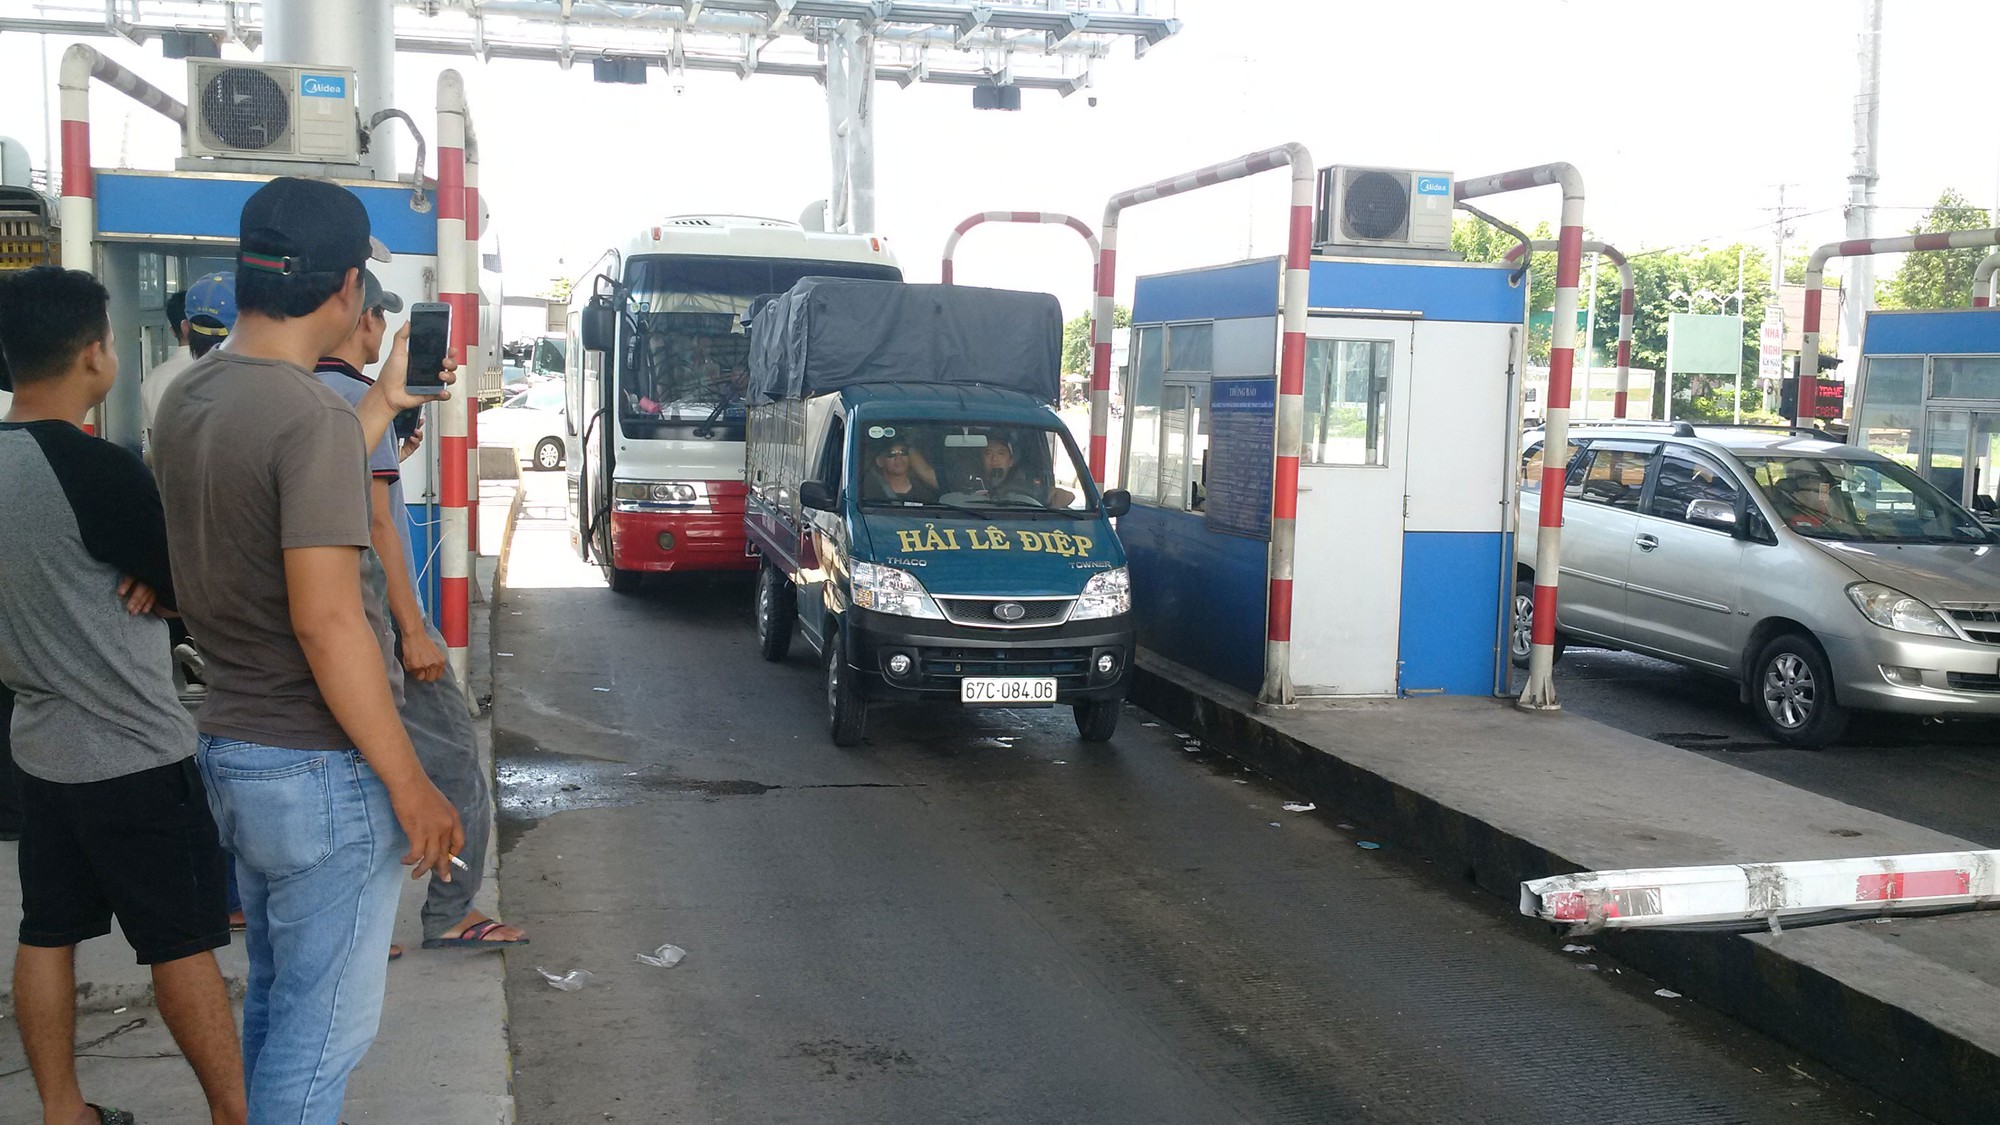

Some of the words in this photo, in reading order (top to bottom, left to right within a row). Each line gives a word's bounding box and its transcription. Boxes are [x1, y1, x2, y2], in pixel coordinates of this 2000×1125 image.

[308, 82, 341, 93] Midea
[1423, 182, 1446, 192] Midea
[896, 523, 961, 552] HẢI
[965, 525, 1010, 550] LÊ
[1016, 529, 1094, 558] ĐIỆP
[886, 556, 928, 567] THACO
[1068, 561, 1113, 570] TOWNER
[966, 682, 1053, 699] 67C-084.06
